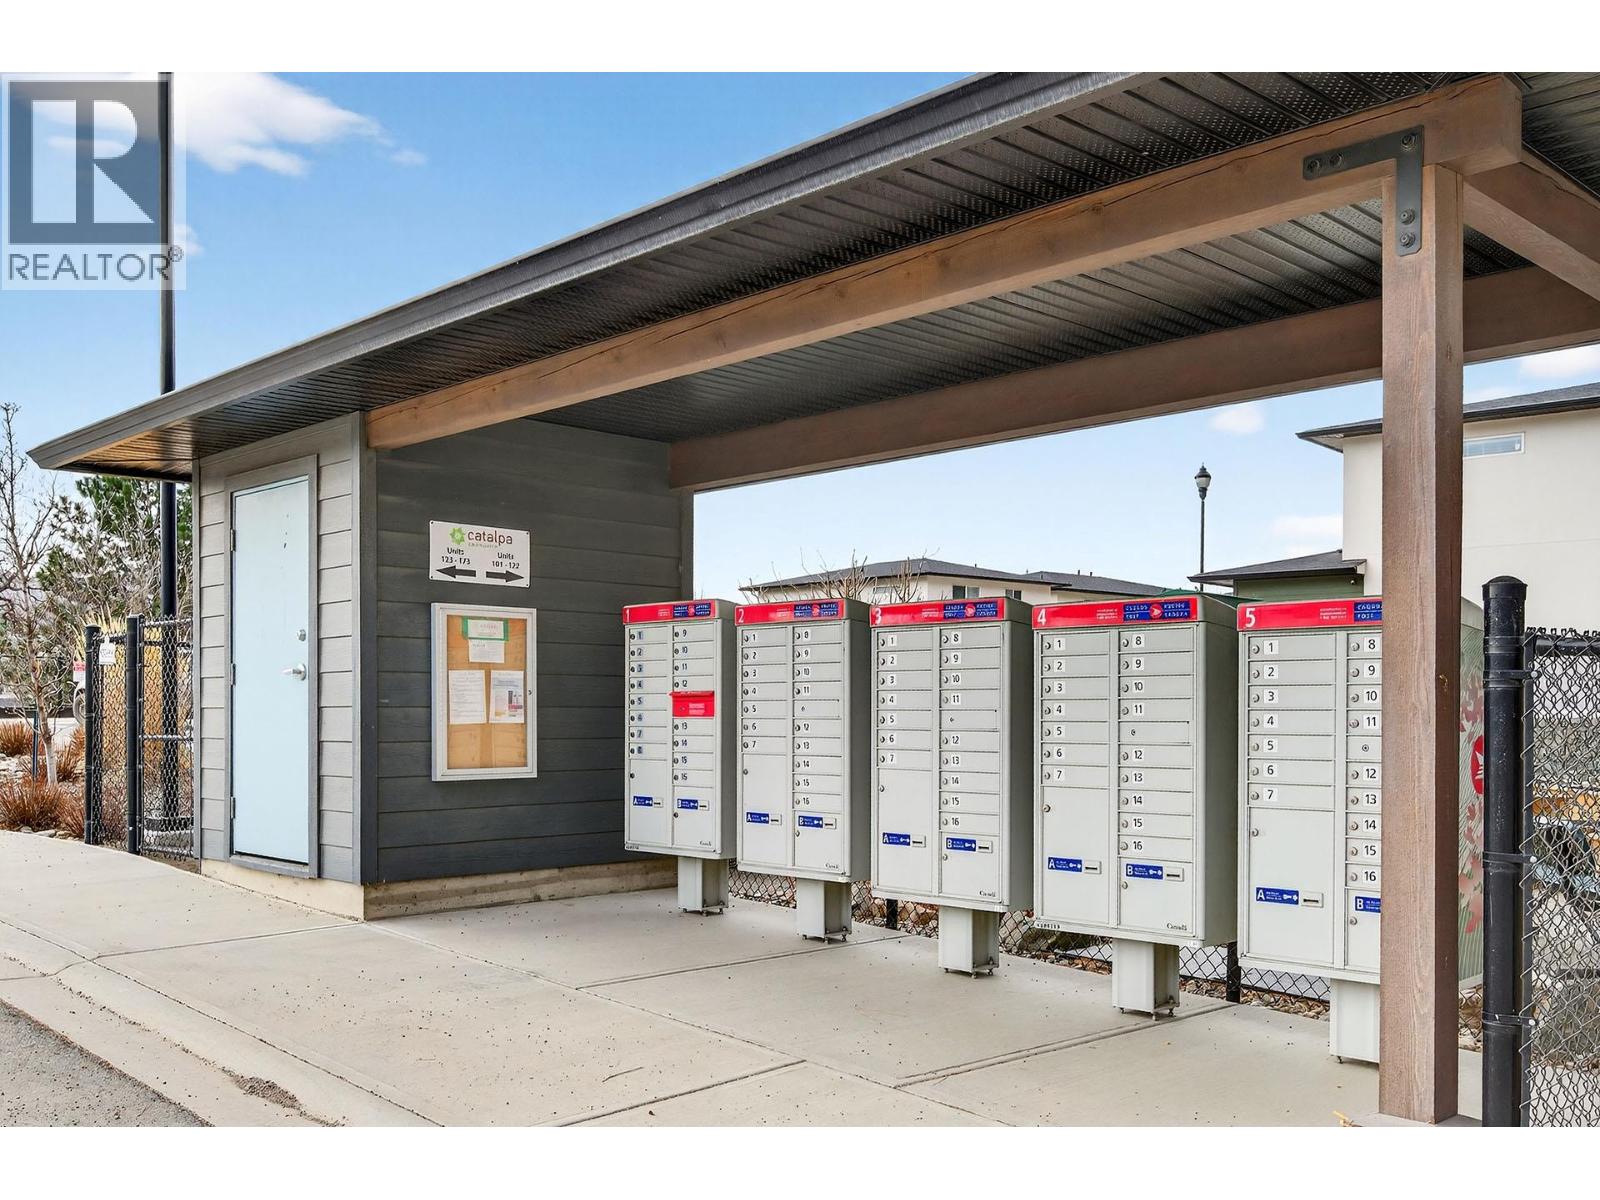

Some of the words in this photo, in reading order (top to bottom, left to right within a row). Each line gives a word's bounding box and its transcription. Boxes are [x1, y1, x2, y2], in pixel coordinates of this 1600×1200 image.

[467, 530, 513, 546] catalpa
[447, 547, 465, 556] Units
[497, 552, 514, 560] Units
[626, 609, 630, 621] 1
[738, 609, 744, 623] 2
[873, 608, 882, 624] 3
[1037, 609, 1047, 625] 4
[1245, 608, 1256, 628] 5
[752, 633, 756, 641] 1
[804, 630, 809, 639] 8
[953, 633, 959, 643] 8
[890, 636, 894, 645] 1
[1057, 639, 1061, 648] 1
[1135, 635, 1142, 646] 8
[1368, 638, 1376, 650] 8
[1268, 642, 1273, 653] 1
[752, 651, 757, 660] 2
[804, 649, 809, 658] 9
[953, 654, 959, 663] 9
[890, 656, 895, 665] 2
[1135, 658, 1142, 669] 9
[1057, 661, 1063, 671] 2
[1368, 664, 1376, 676] 9
[752, 669, 757, 677] 3
[803, 667, 810, 676] 10
[1267, 666, 1275, 677] 2
[890, 675, 895, 685] 3
[952, 674, 960, 683] 10
[751, 687, 757, 695] 4
[803, 686, 810, 694] 11
[1057, 682, 1063, 693] 3
[1134, 681, 1144, 691] 10
[889, 695, 894, 703] 4
[952, 694, 960, 703] 11
[1268, 690, 1275, 702] 3
[1365, 690, 1378, 702] 10
[752, 704, 757, 713] 5
[1056, 704, 1062, 714] 4
[1134, 704, 1143, 714] 11
[889, 714, 895, 724] 5
[1266, 715, 1274, 726] 4
[1366, 716, 1376, 727] 11
[751, 722, 757, 731] 6
[1056, 726, 1062, 736] 5
[889, 734, 895, 743] 6
[951, 735, 960, 745] 12
[752, 740, 757, 748] 7
[803, 741, 810, 750] 13
[1267, 740, 1274, 751] 5
[889, 753, 895, 763] 7
[1056, 748, 1063, 758] 6
[1134, 749, 1143, 760] 12
[803, 759, 810, 768] 14
[952, 755, 960, 765] 13
[1057, 769, 1062, 779] 7
[1267, 764, 1274, 776] 6
[1365, 768, 1377, 779] 12
[951, 776, 960, 785] 14
[1133, 772, 1143, 782] 13
[803, 778, 810, 787] 15
[1267, 789, 1274, 800] 7
[1365, 793, 1377, 805] 13
[802, 797, 810, 806] 16
[951, 796, 960, 806] 15
[1132, 795, 1143, 805] 14
[951, 817, 960, 826] 16
[1133, 818, 1143, 828] 15
[1364, 819, 1377, 830] 14
[883, 834, 889, 843] A
[947, 839, 953, 848] B
[1133, 840, 1143, 851] 16
[1364, 845, 1377, 856] 15
[1049, 860, 1056, 869] A
[1127, 865, 1134, 875] B
[1364, 870, 1377, 882] 16
[1257, 890, 1265, 901] A
[1357, 899, 1364, 910] B
